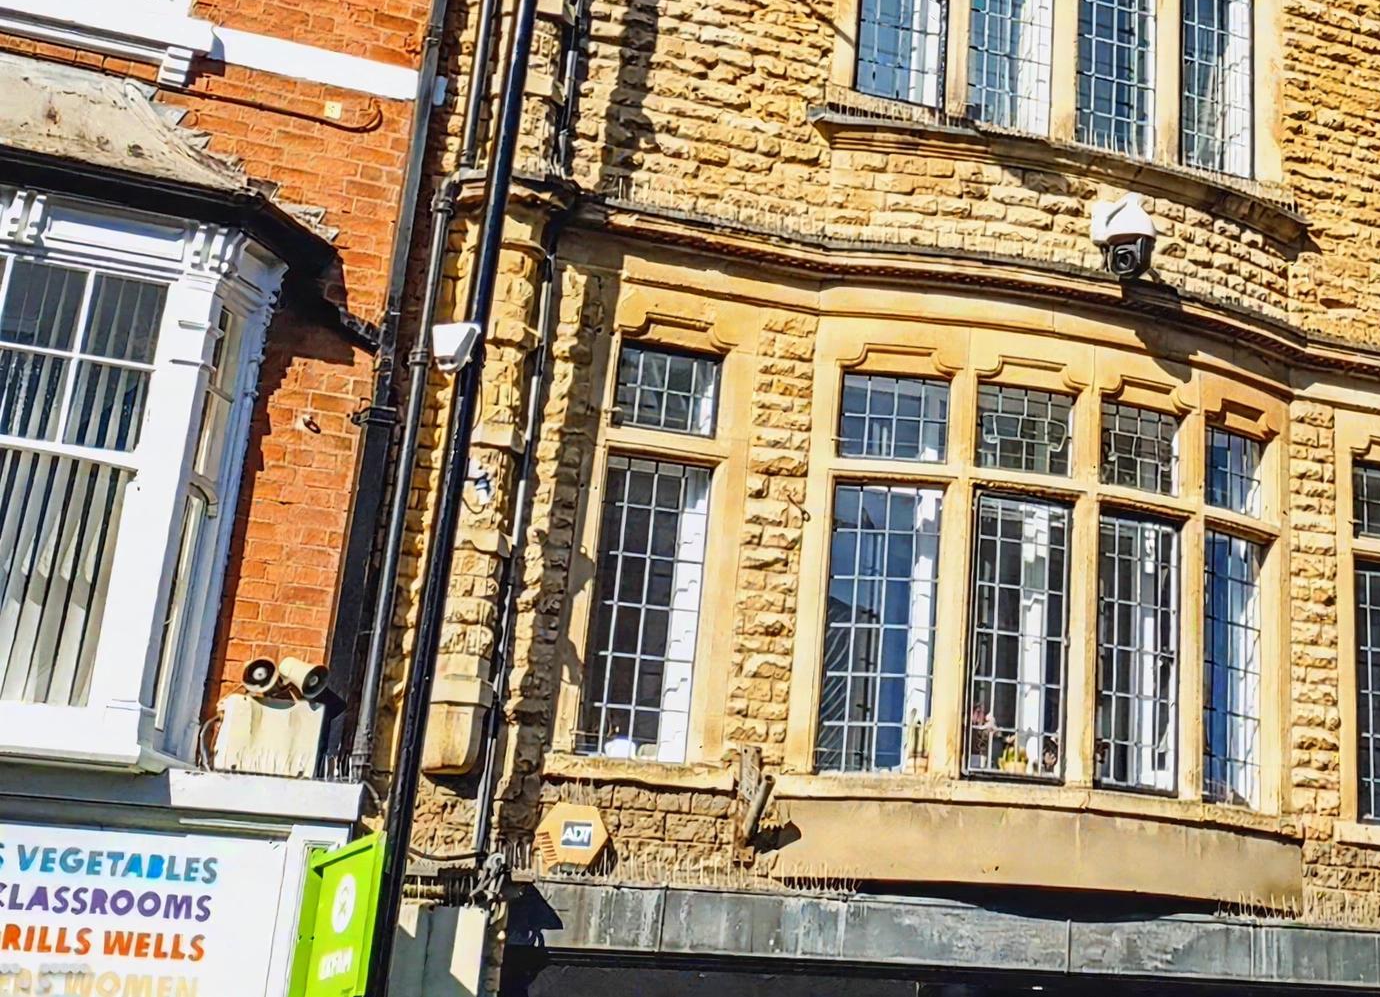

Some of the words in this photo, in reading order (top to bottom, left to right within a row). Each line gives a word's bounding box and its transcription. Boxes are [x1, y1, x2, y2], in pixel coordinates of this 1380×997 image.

[561, 825, 593, 844] ADT
[17, 844, 219, 884] VEGETABLES
[0, 923, 93, 955] RILLS
[103, 930, 206, 962] WELLS
[64, 970, 200, 997] WOMEN
